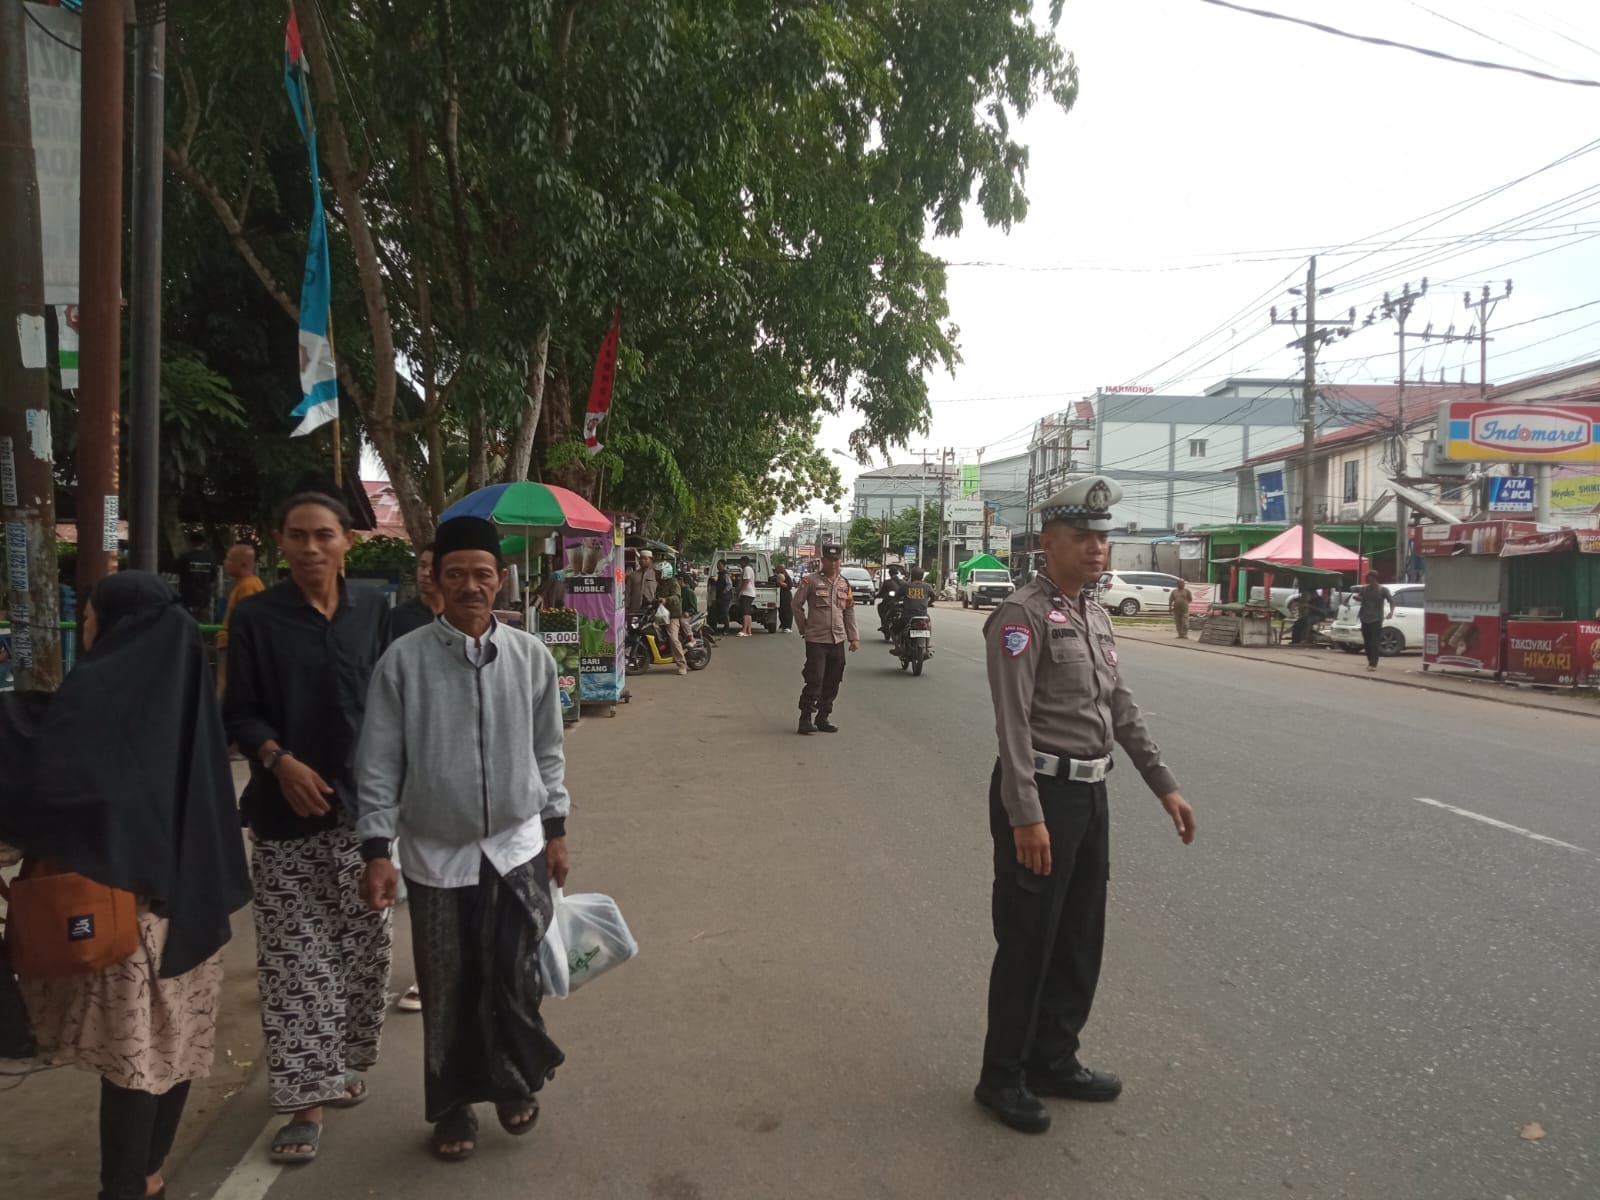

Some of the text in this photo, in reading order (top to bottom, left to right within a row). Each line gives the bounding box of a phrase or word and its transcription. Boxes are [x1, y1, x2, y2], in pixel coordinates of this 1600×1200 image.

[1105, 385, 1153, 393] HARMONIS
[1479, 420, 1583, 442] Indomaret
[1504, 479, 1527, 489] ATM
[1510, 490, 1531, 499] BCA
[546, 632, 578, 643] 5.000
[1511, 638, 1552, 651] TAKOYAKI
[1523, 651, 1572, 671] HIKARI
